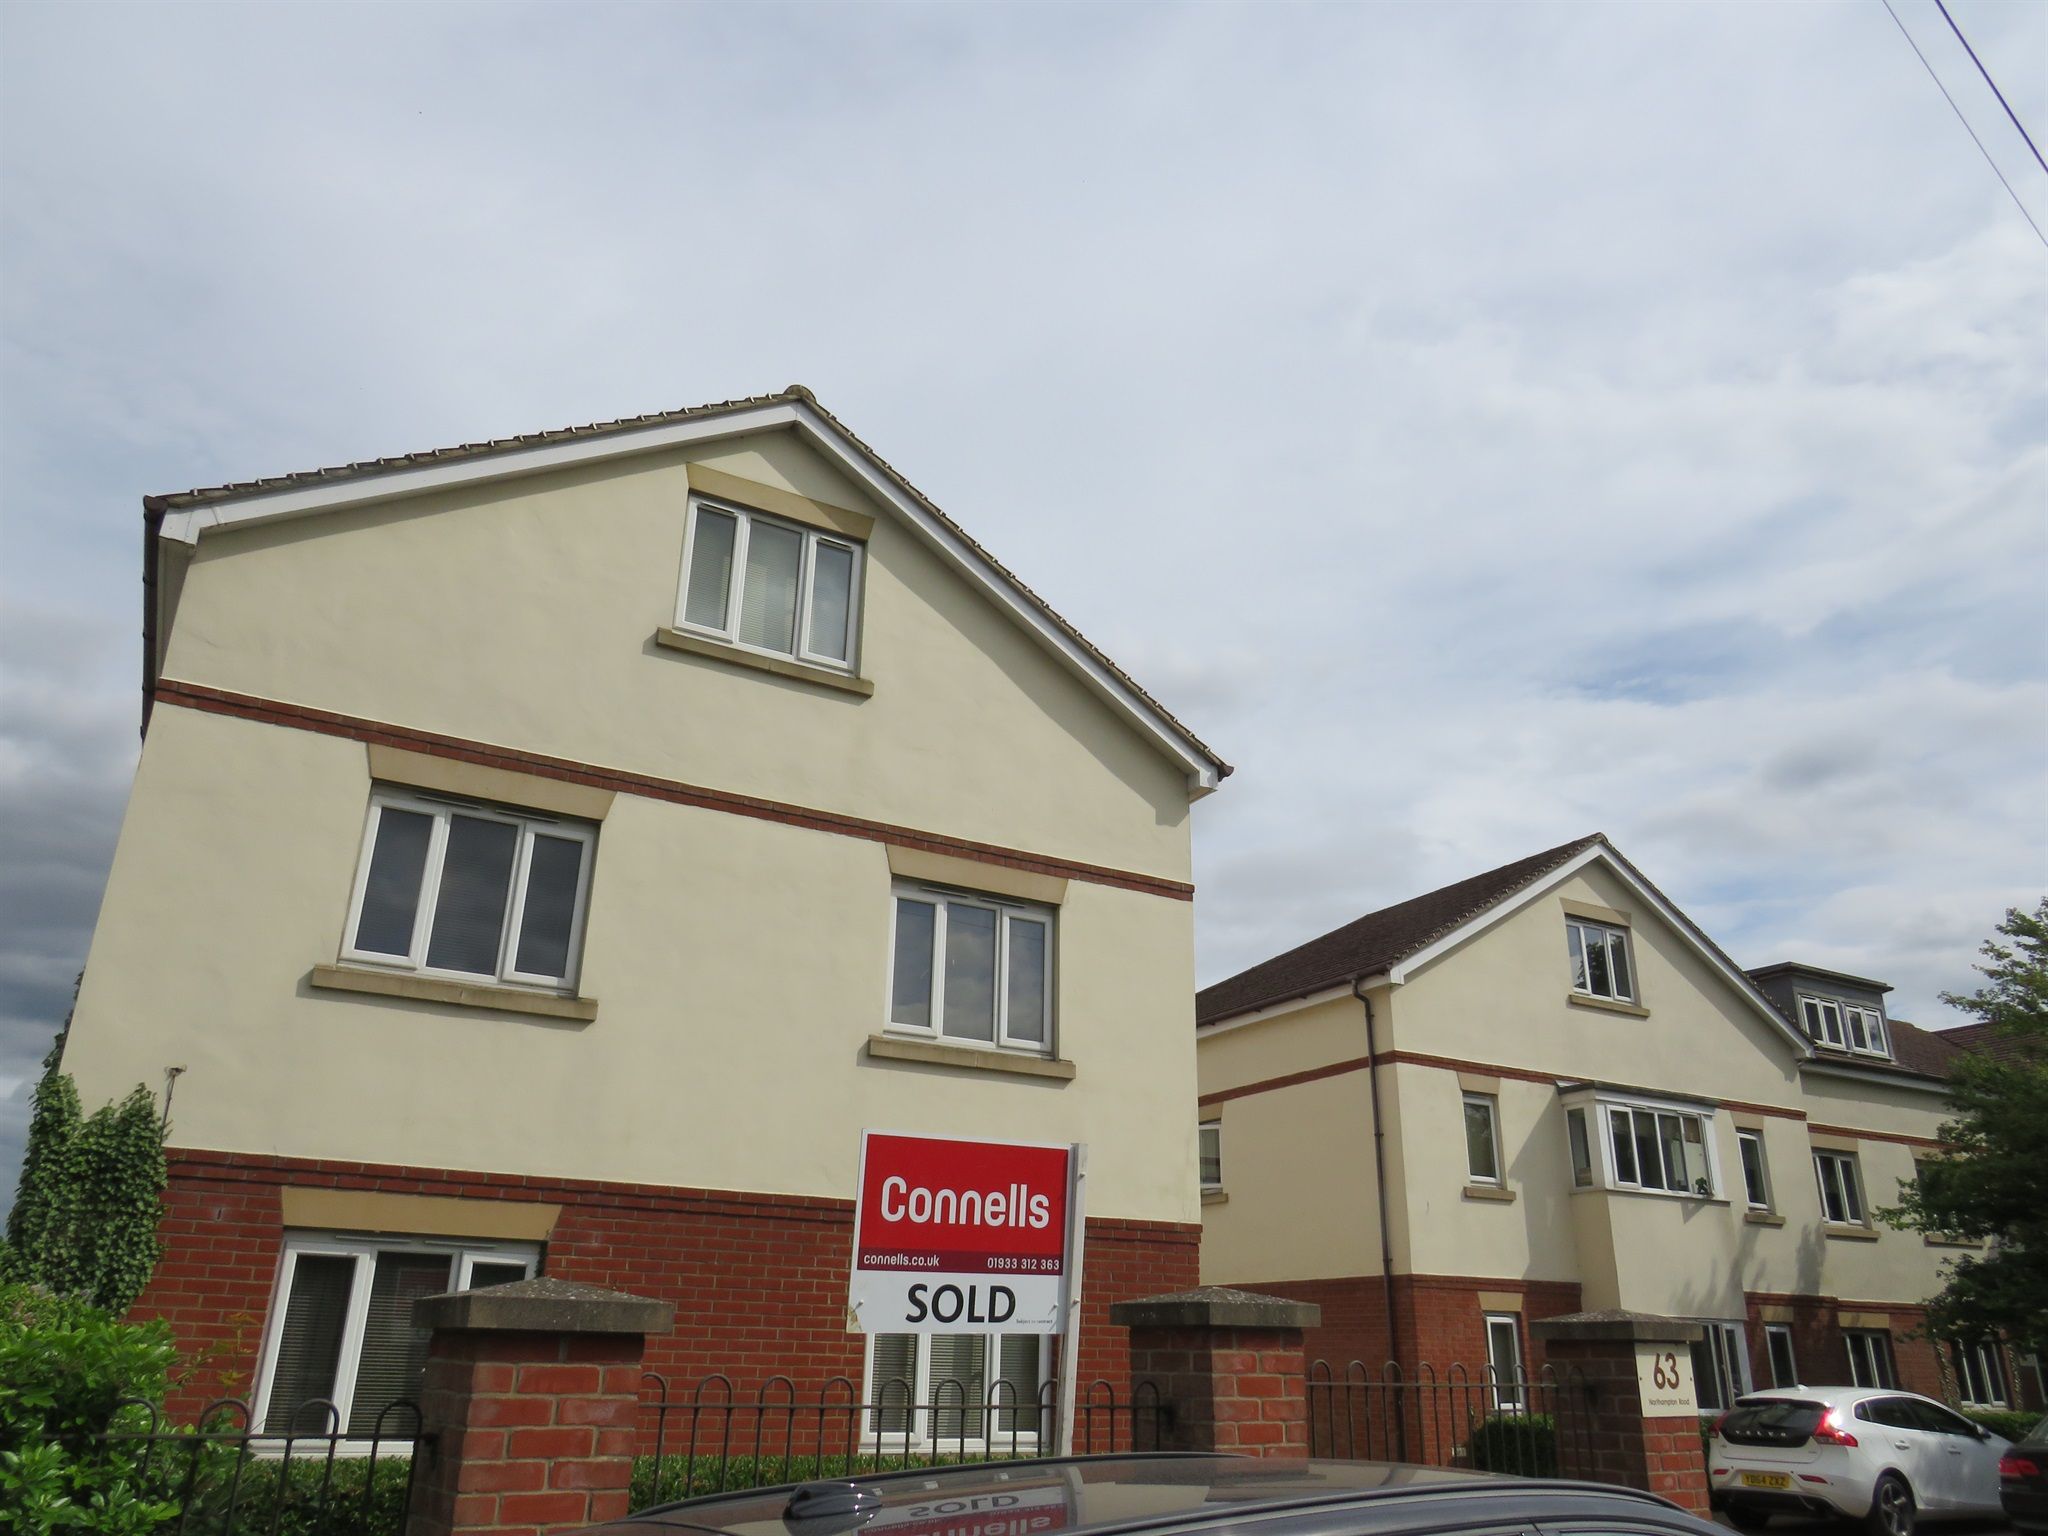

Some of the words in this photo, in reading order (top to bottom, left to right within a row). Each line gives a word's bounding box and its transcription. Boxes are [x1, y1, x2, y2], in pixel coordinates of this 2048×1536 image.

[880, 1175, 1050, 1229] Connells
[863, 1253, 940, 1267] connells.co.uk
[987, 1257, 1018, 1269] 01933
[1020, 1258, 1037, 1270] 312
[1040, 1258, 1060, 1270] 363
[905, 1283, 1016, 1324] SOLD
[1653, 1352, 1680, 1390] 63
[1648, 1398, 1677, 1407] Northampton
[1678, 1398, 1690, 1406] Road
